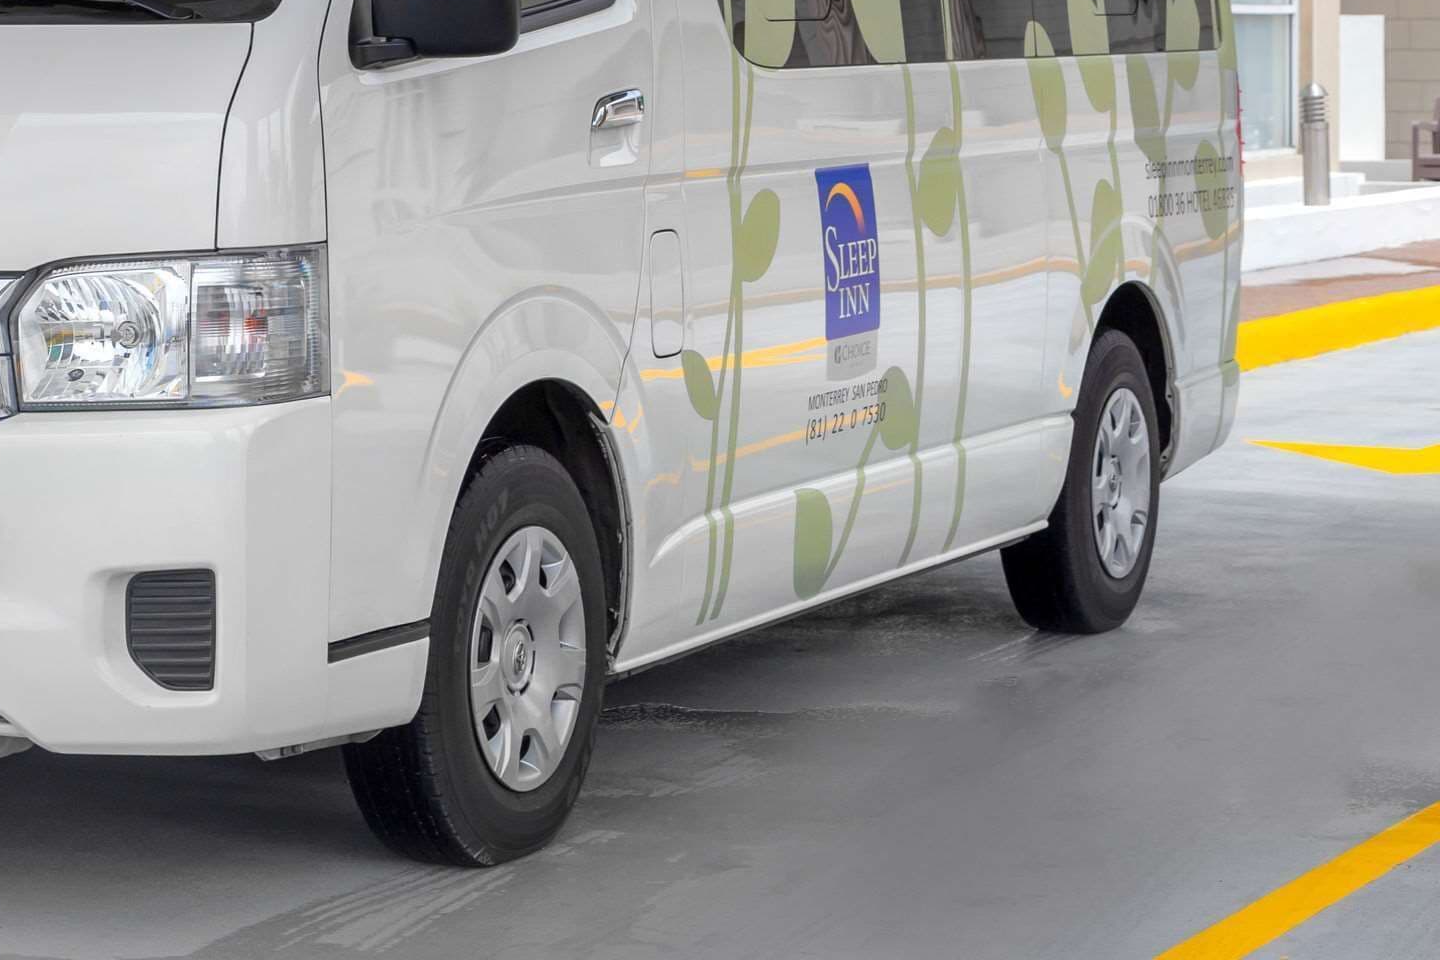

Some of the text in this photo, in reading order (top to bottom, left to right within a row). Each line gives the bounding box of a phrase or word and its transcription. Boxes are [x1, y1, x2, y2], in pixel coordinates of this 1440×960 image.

[1186, 190, 1212, 213] HOTEL
[824, 226, 877, 292] SLEEP
[839, 282, 870, 319] INN
[842, 340, 871, 361] CHOICE
[808, 378, 888, 411] MONTERREY SAN PEDRO
[806, 415, 827, 446] (81)
[863, 401, 886, 426] 7530
